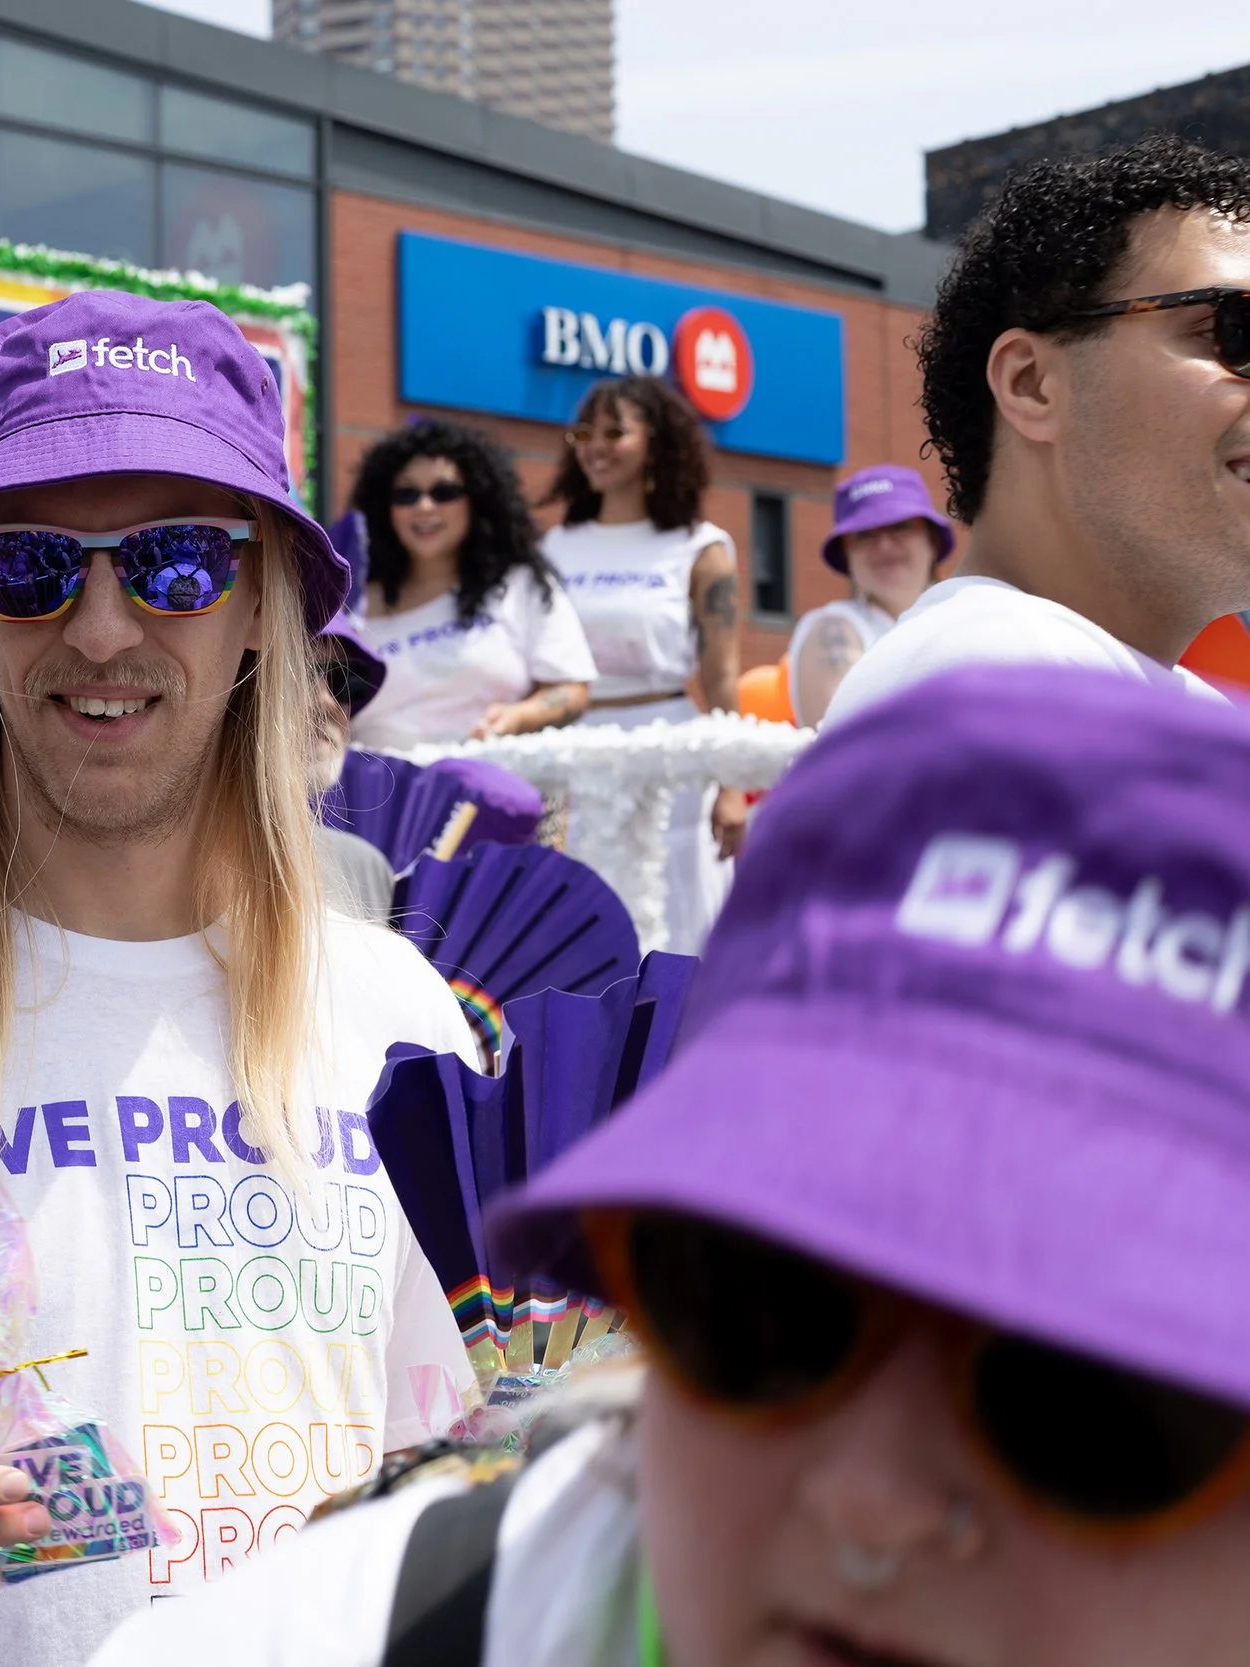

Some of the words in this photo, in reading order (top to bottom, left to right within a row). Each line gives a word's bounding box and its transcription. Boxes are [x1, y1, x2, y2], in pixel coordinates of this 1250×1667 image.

[91, 337, 196, 383] fetch
[542, 306, 669, 378] BMO
[126, 1174, 387, 1258] PROUD
[134, 1255, 385, 1337] PROUD
[143, 1422, 377, 1499] PROUD
